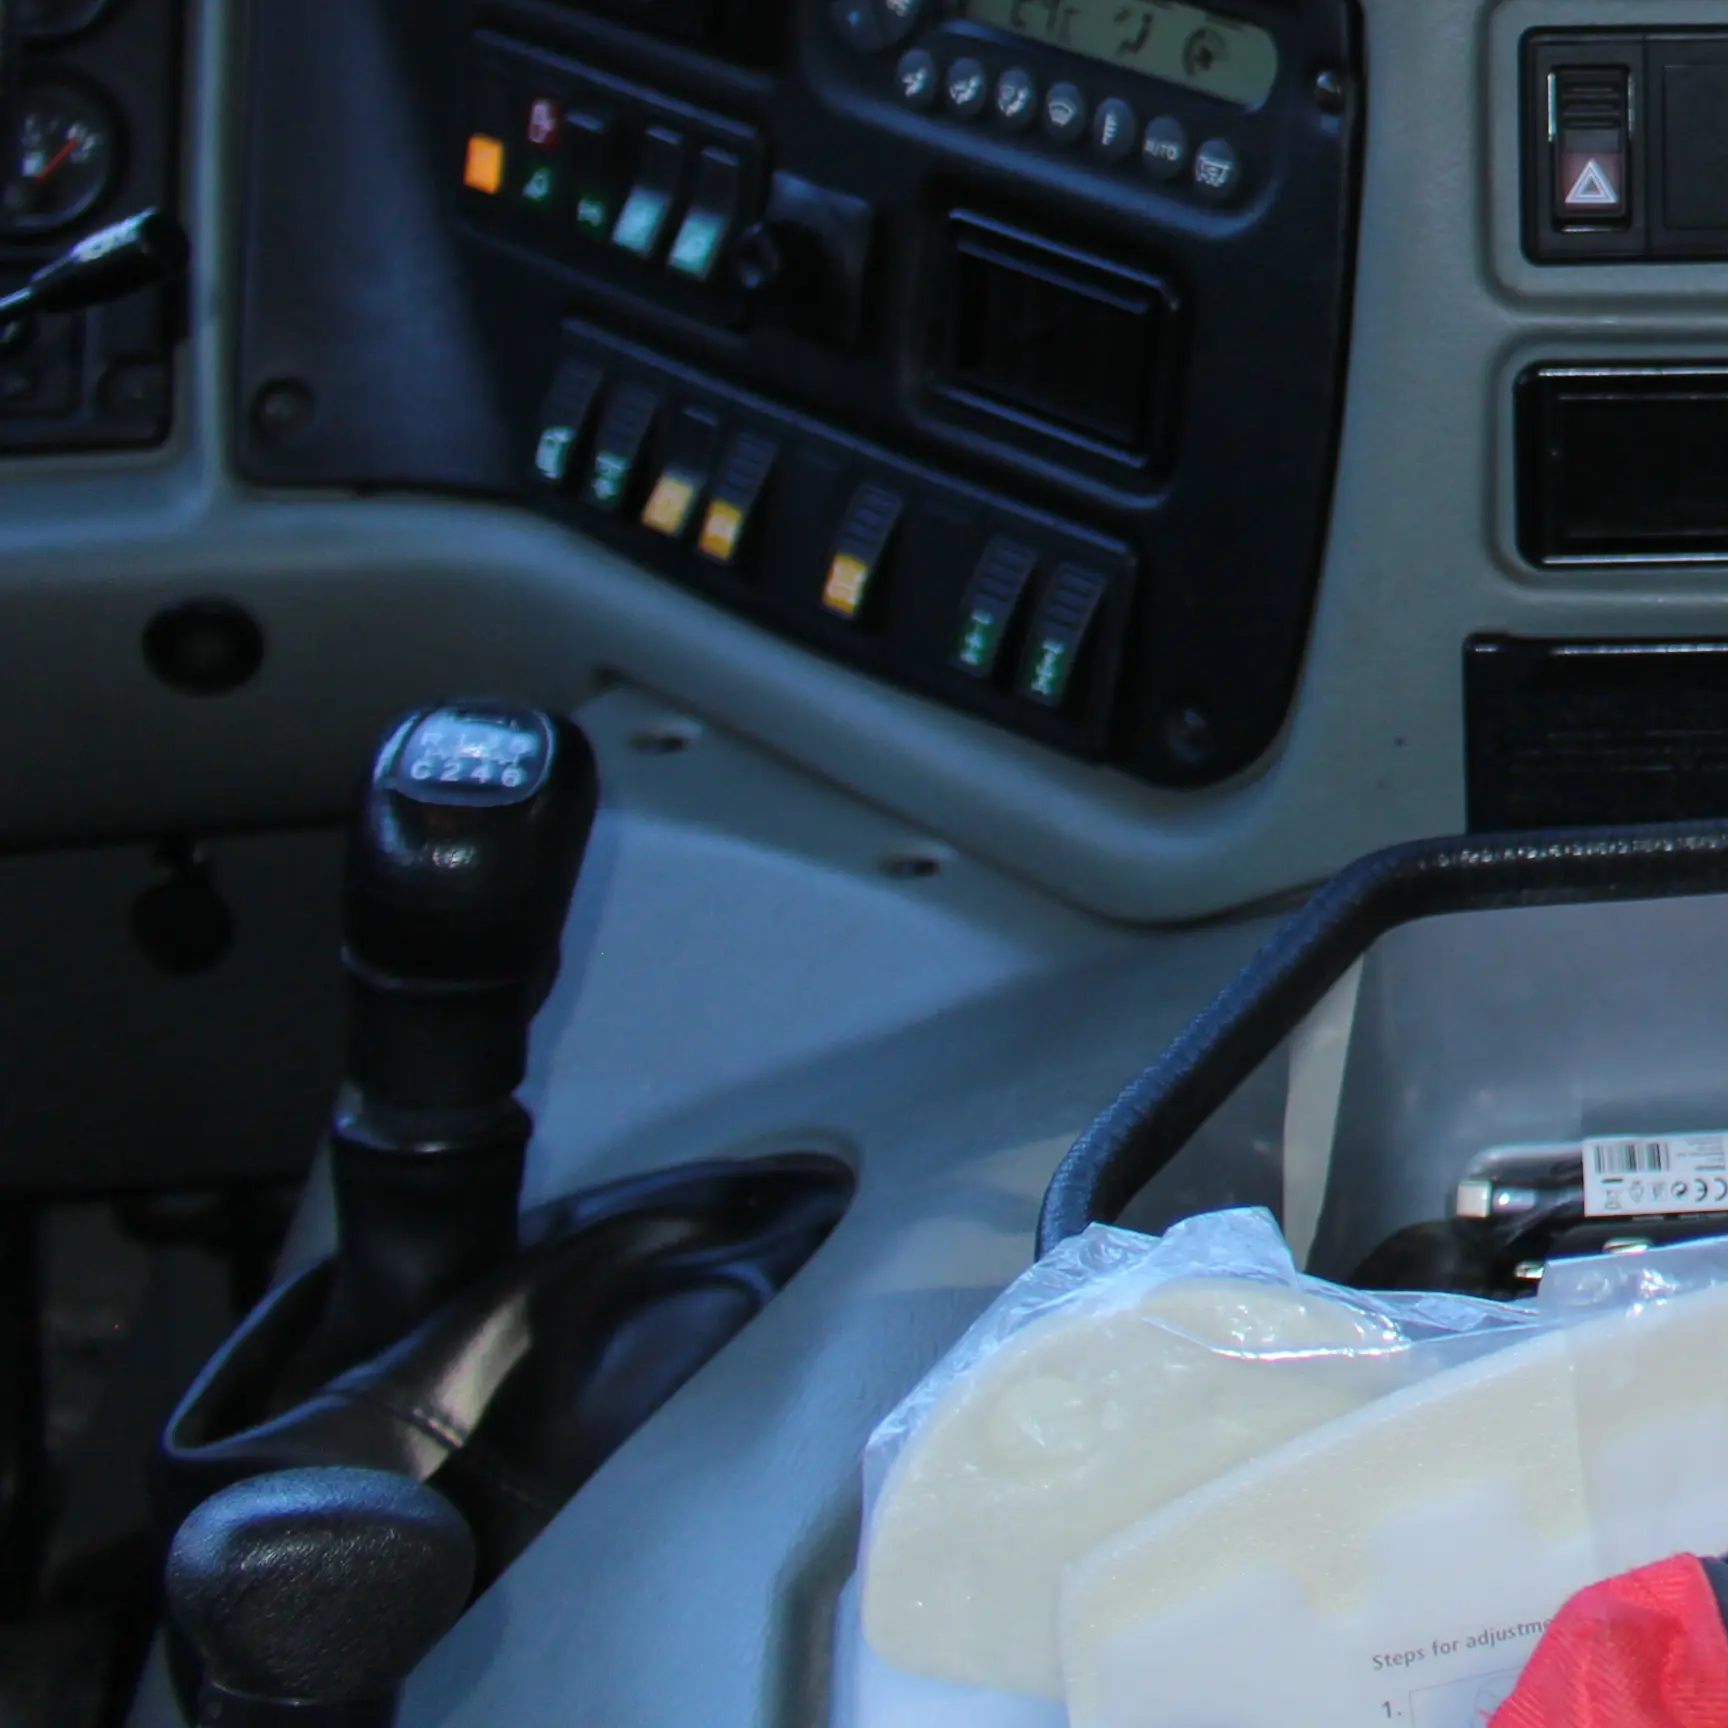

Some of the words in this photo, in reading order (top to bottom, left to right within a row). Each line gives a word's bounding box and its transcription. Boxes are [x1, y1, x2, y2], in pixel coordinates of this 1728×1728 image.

[1144, 137, 1179, 162] AUTO
[440, 759, 461, 782] 2
[1371, 1648, 1425, 1670] Steps
[1432, 1640, 1461, 1656] for
[1382, 1701, 1403, 1719] 1.
